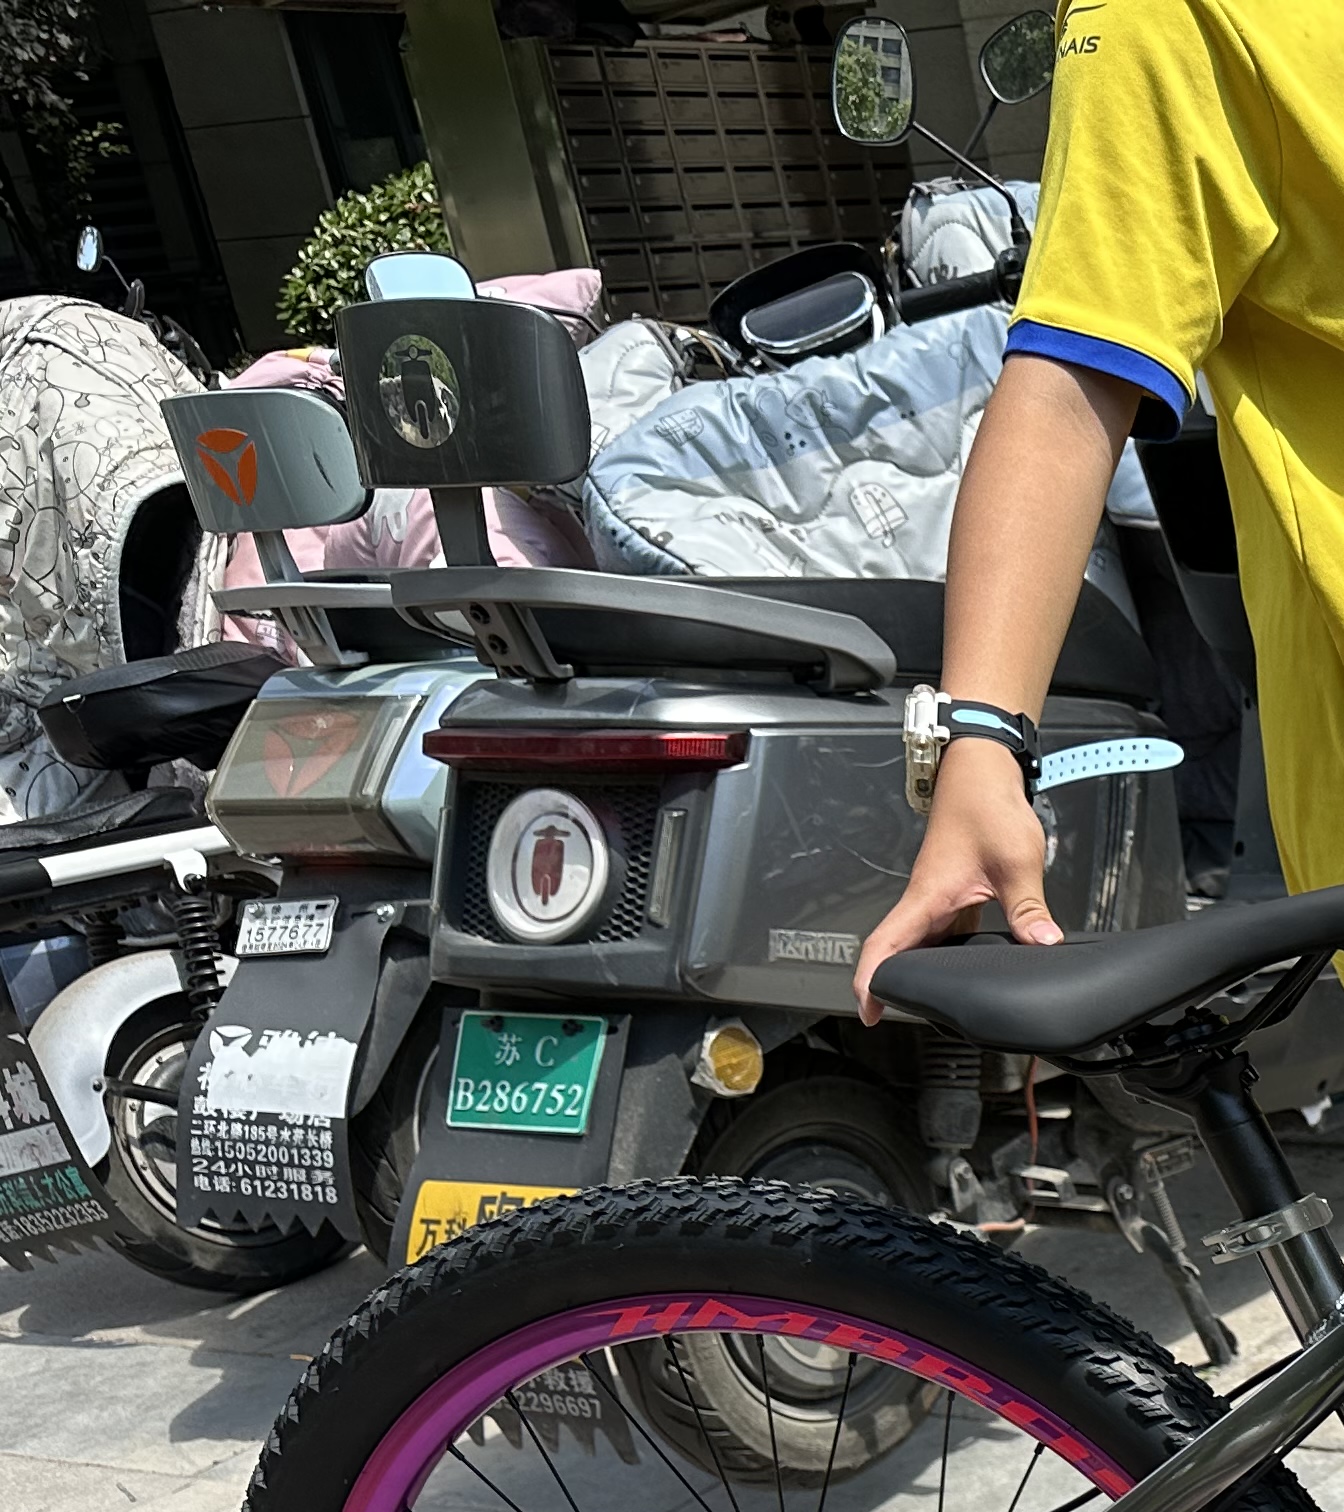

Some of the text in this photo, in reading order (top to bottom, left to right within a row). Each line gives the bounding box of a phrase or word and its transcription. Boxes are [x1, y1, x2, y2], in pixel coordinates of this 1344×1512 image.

[246, 922, 325, 944] 1577677
[494, 1033, 559, 1068] 苏 C
[454, 1077, 584, 1117] B286752
[500, 1388, 601, 1420] 2296697
